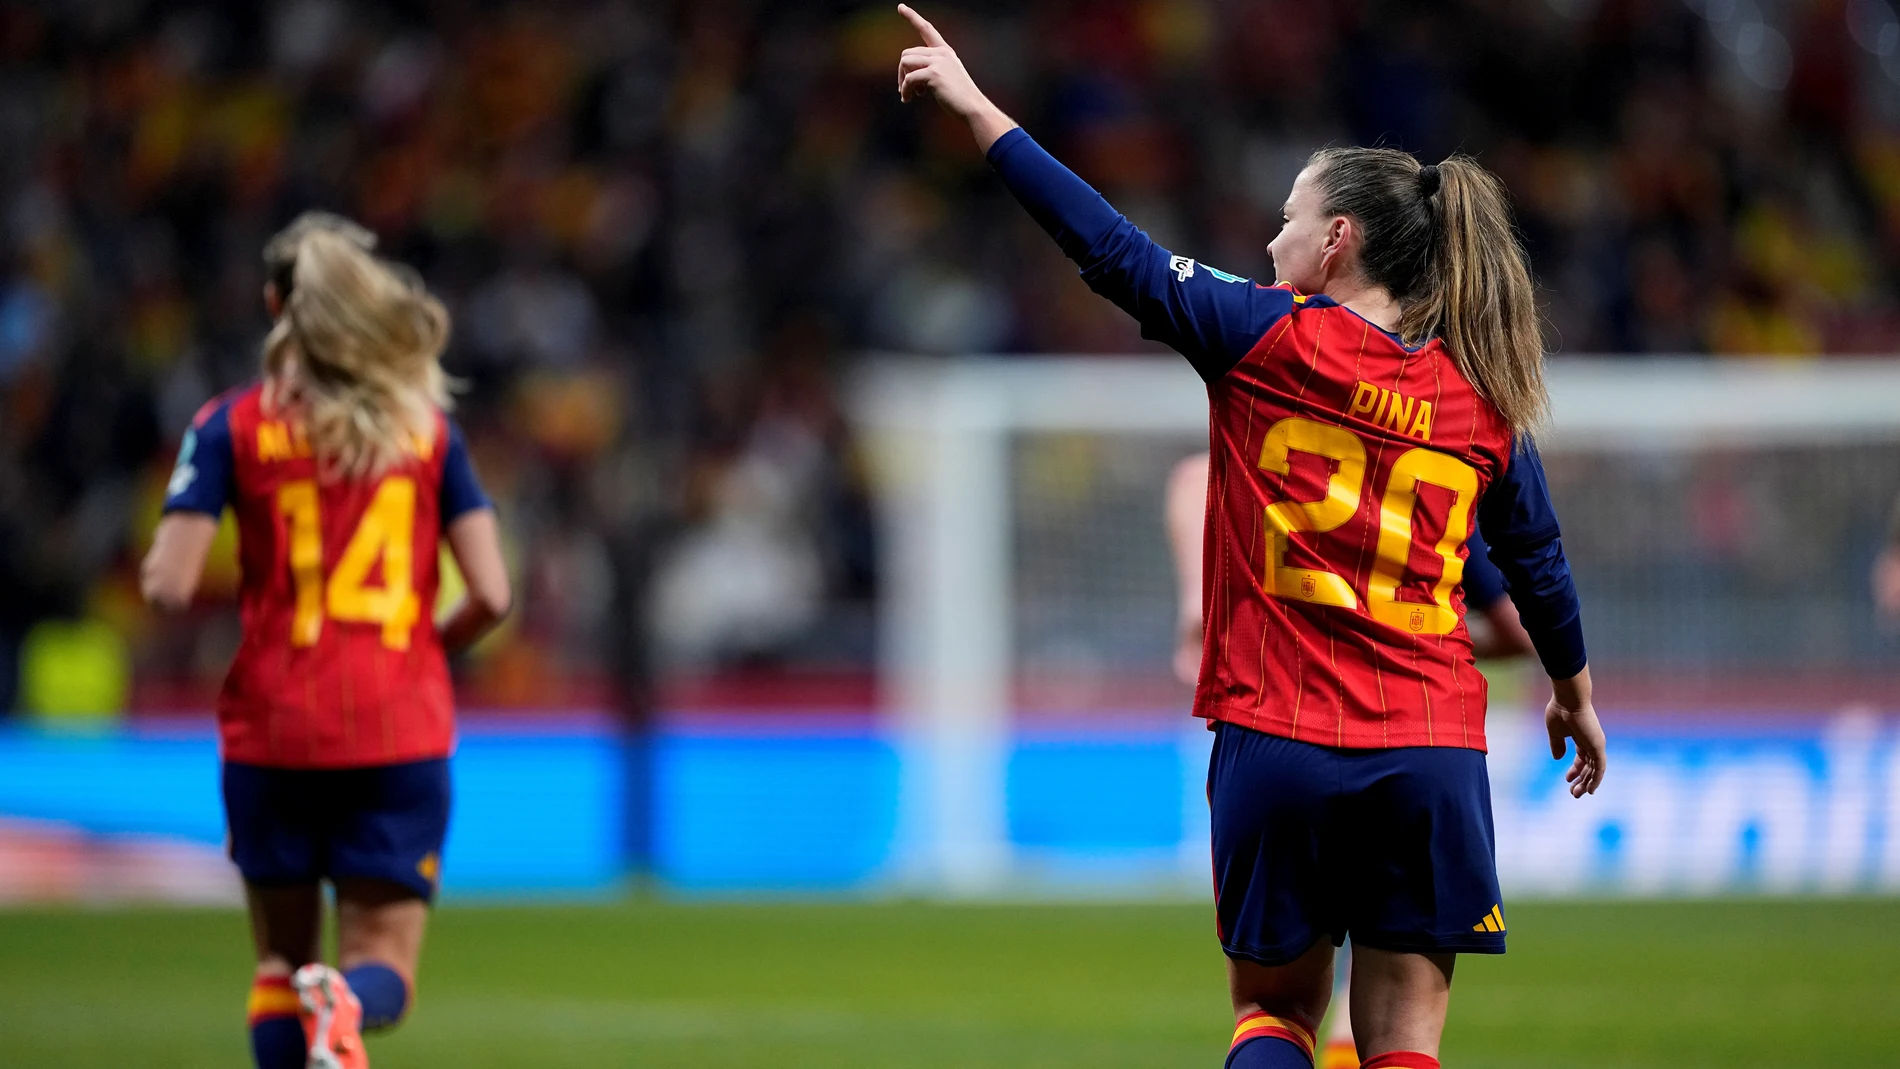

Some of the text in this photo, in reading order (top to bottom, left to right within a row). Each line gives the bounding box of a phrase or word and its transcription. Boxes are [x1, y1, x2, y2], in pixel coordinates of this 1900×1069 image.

[1348, 381, 1432, 441] PINA
[277, 477, 420, 651] 14
[1258, 417, 1478, 635] 20
